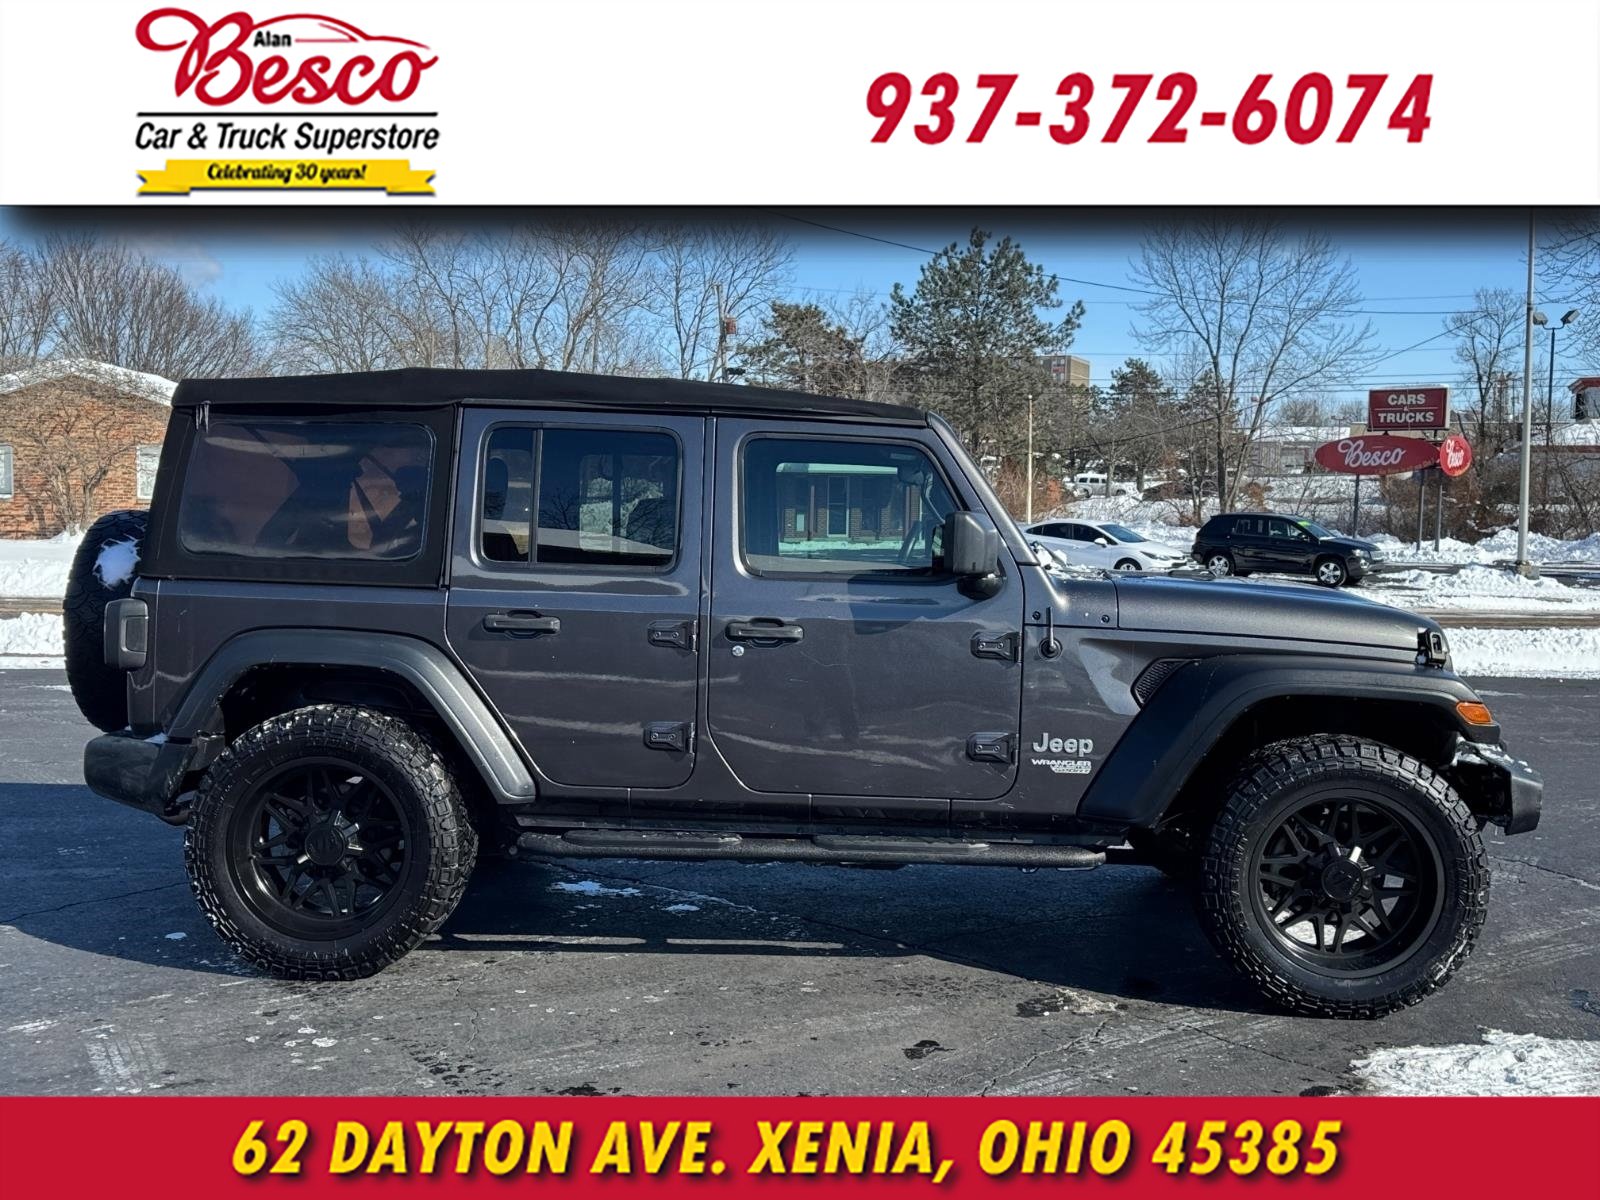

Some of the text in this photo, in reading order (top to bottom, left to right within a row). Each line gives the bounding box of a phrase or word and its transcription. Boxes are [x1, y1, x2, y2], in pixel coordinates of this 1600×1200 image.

[1388, 394, 1426, 405] CARS
[1378, 411, 1434, 423] TRUCKS
[1338, 440, 1407, 467] Besco
[1032, 732, 1093, 757] Jeep
[1031, 758, 1092, 766] WRANGLER
